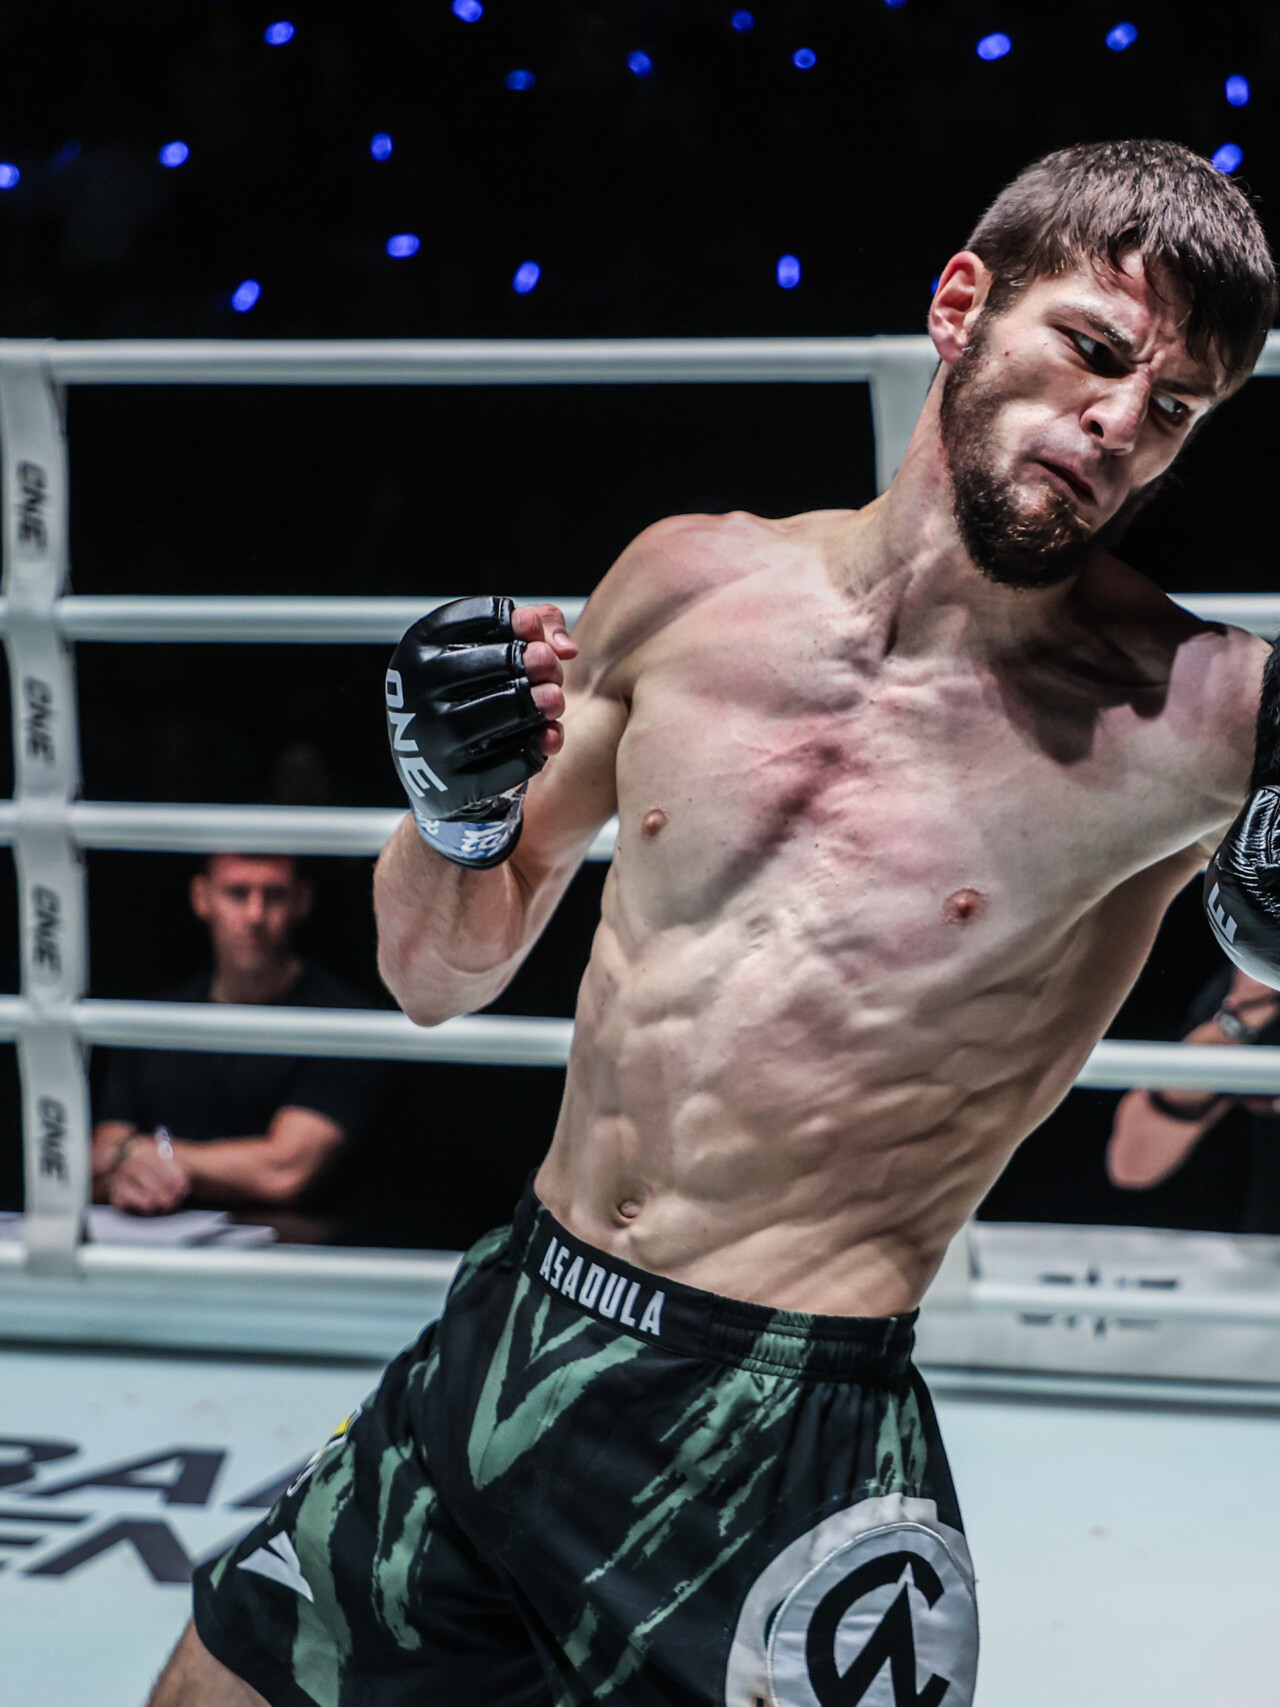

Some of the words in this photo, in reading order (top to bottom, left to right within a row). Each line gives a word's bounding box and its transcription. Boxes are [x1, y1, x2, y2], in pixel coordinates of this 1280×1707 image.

[16, 459, 49, 548] ONE
[22, 674, 56, 766] ONE
[385, 668, 448, 798] ONE
[31, 884, 63, 974] ONE
[37, 1094, 69, 1185] ONE
[539, 1236, 665, 1336] ASADULA
